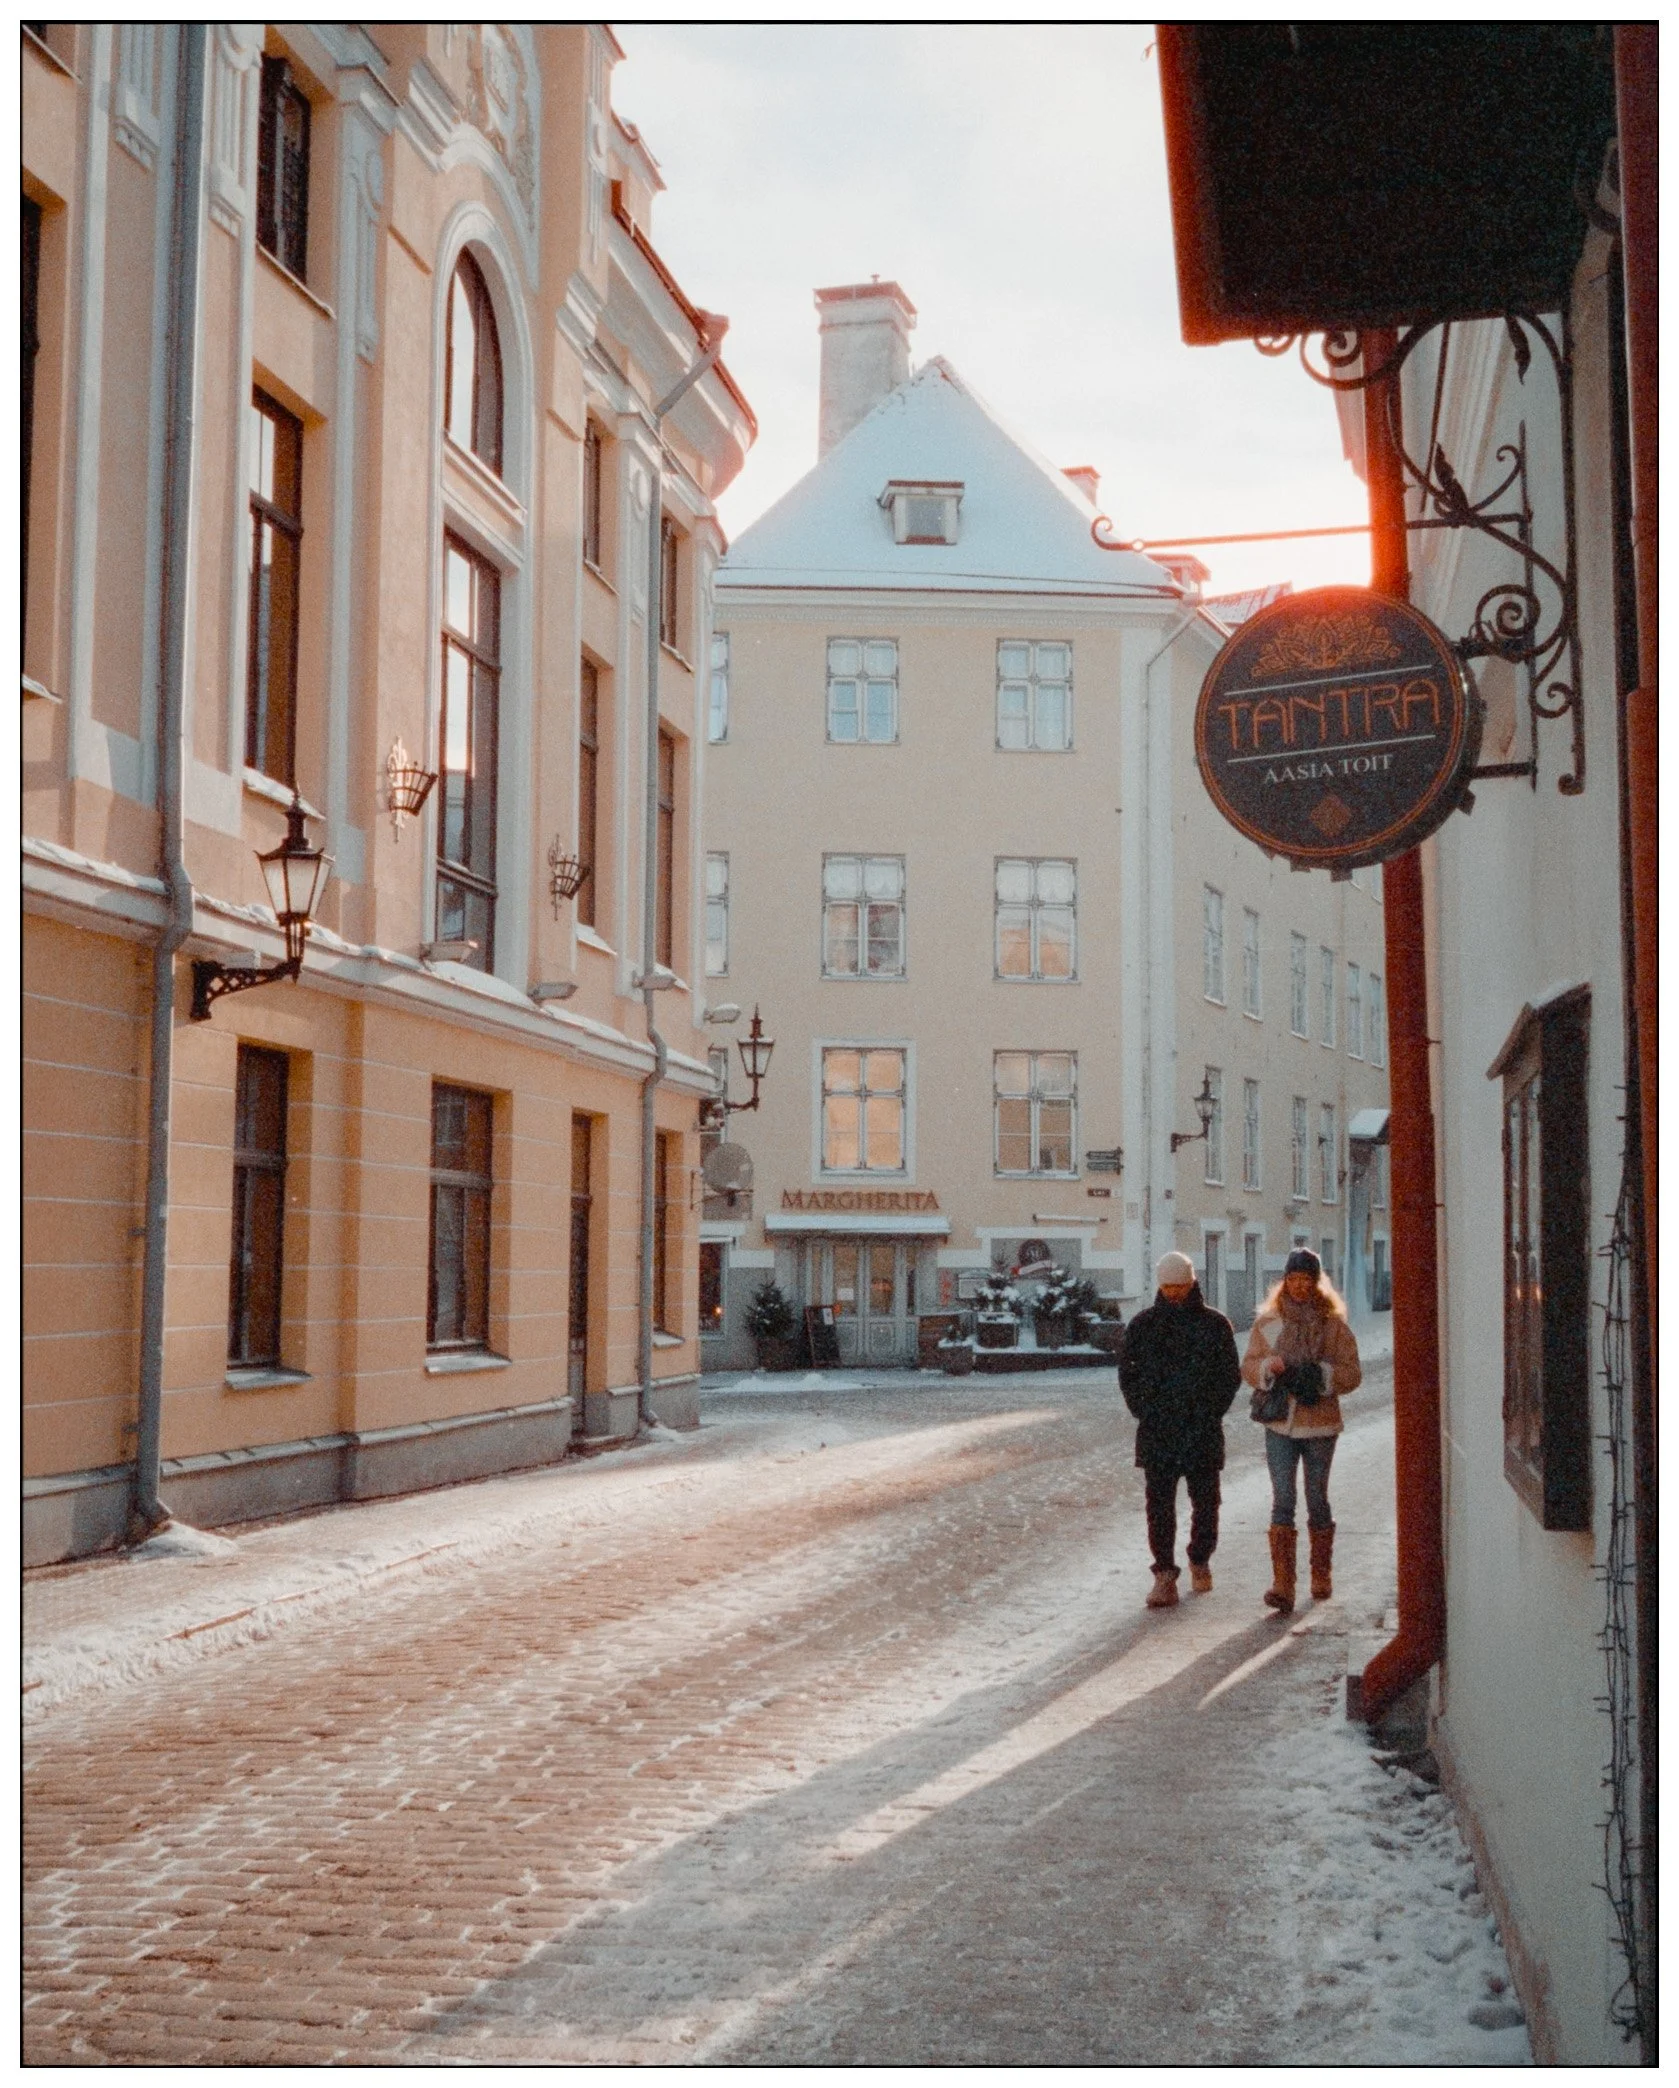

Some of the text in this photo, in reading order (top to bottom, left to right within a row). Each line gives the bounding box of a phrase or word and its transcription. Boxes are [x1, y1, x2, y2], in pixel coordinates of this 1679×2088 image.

[1218, 678, 1441, 749] TANTRA
[1263, 754, 1393, 784] AASIA TOIT
[781, 1188, 940, 1210] MARGHERITA
